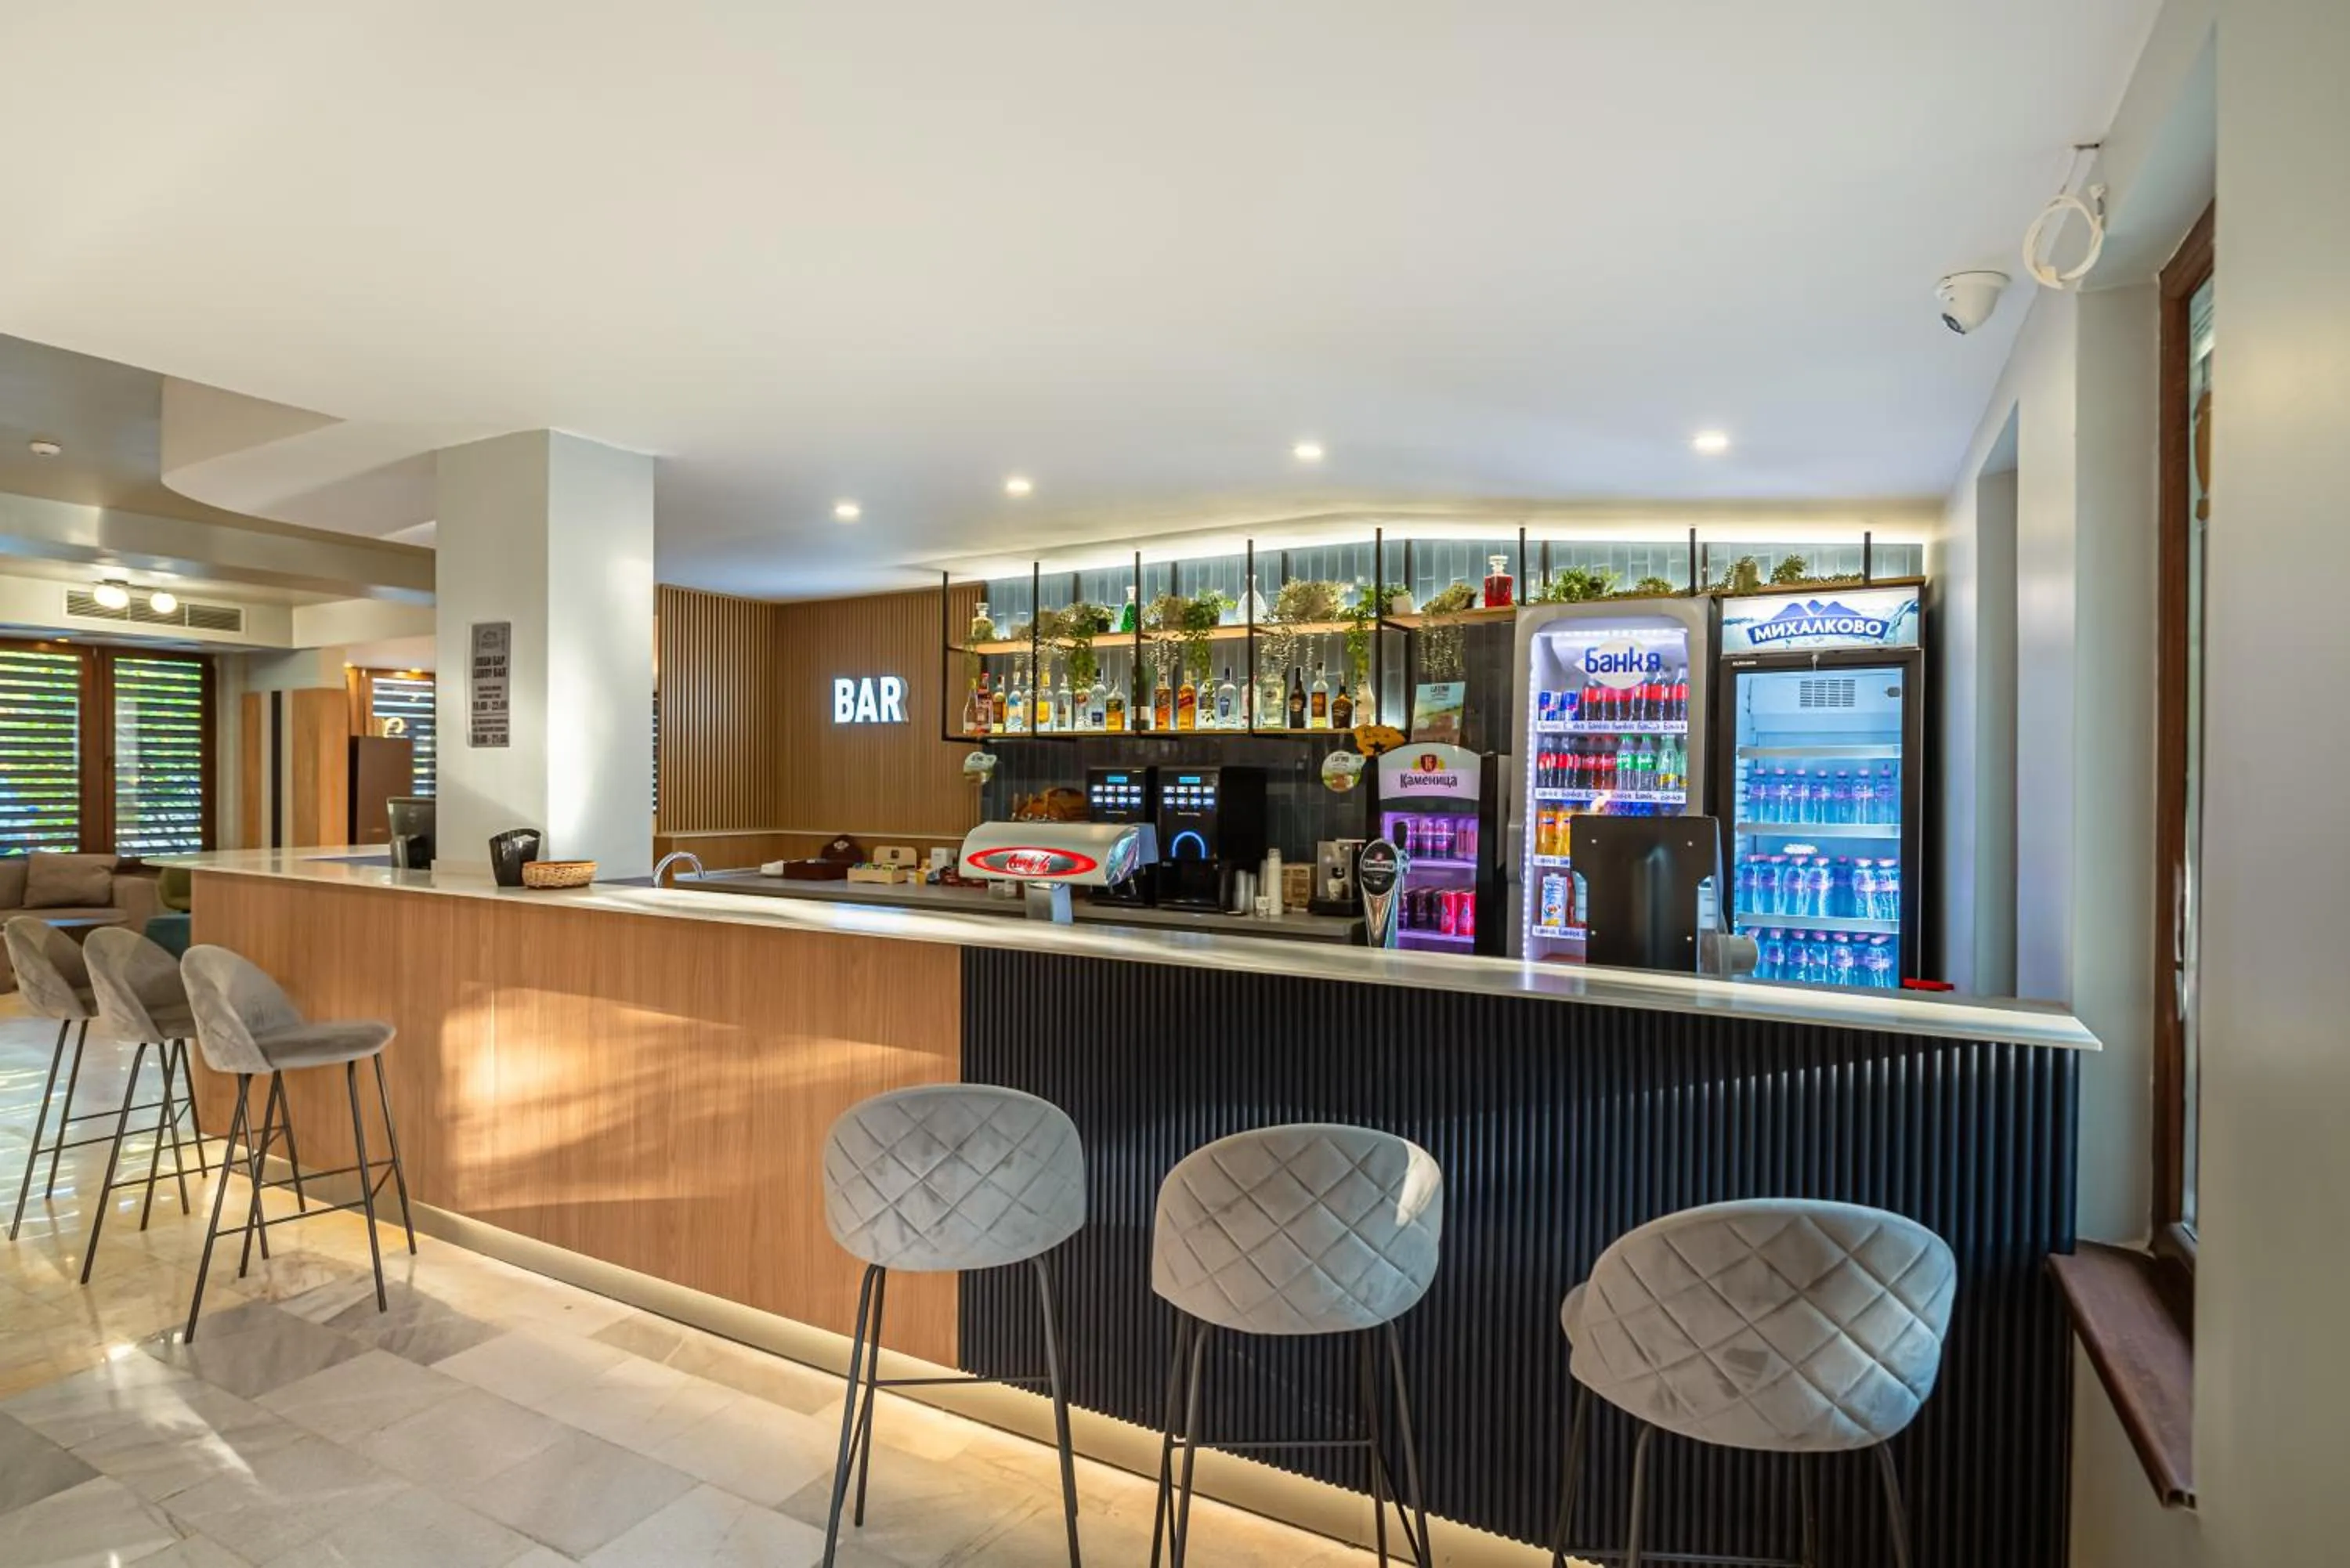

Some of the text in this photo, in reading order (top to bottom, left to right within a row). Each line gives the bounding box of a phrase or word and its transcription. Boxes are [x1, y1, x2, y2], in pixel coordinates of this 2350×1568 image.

[1754, 618, 1882, 642] МИХАЛКОВО
[834, 676, 904, 723] BAR
[1400, 773, 1458, 789] Каменица
